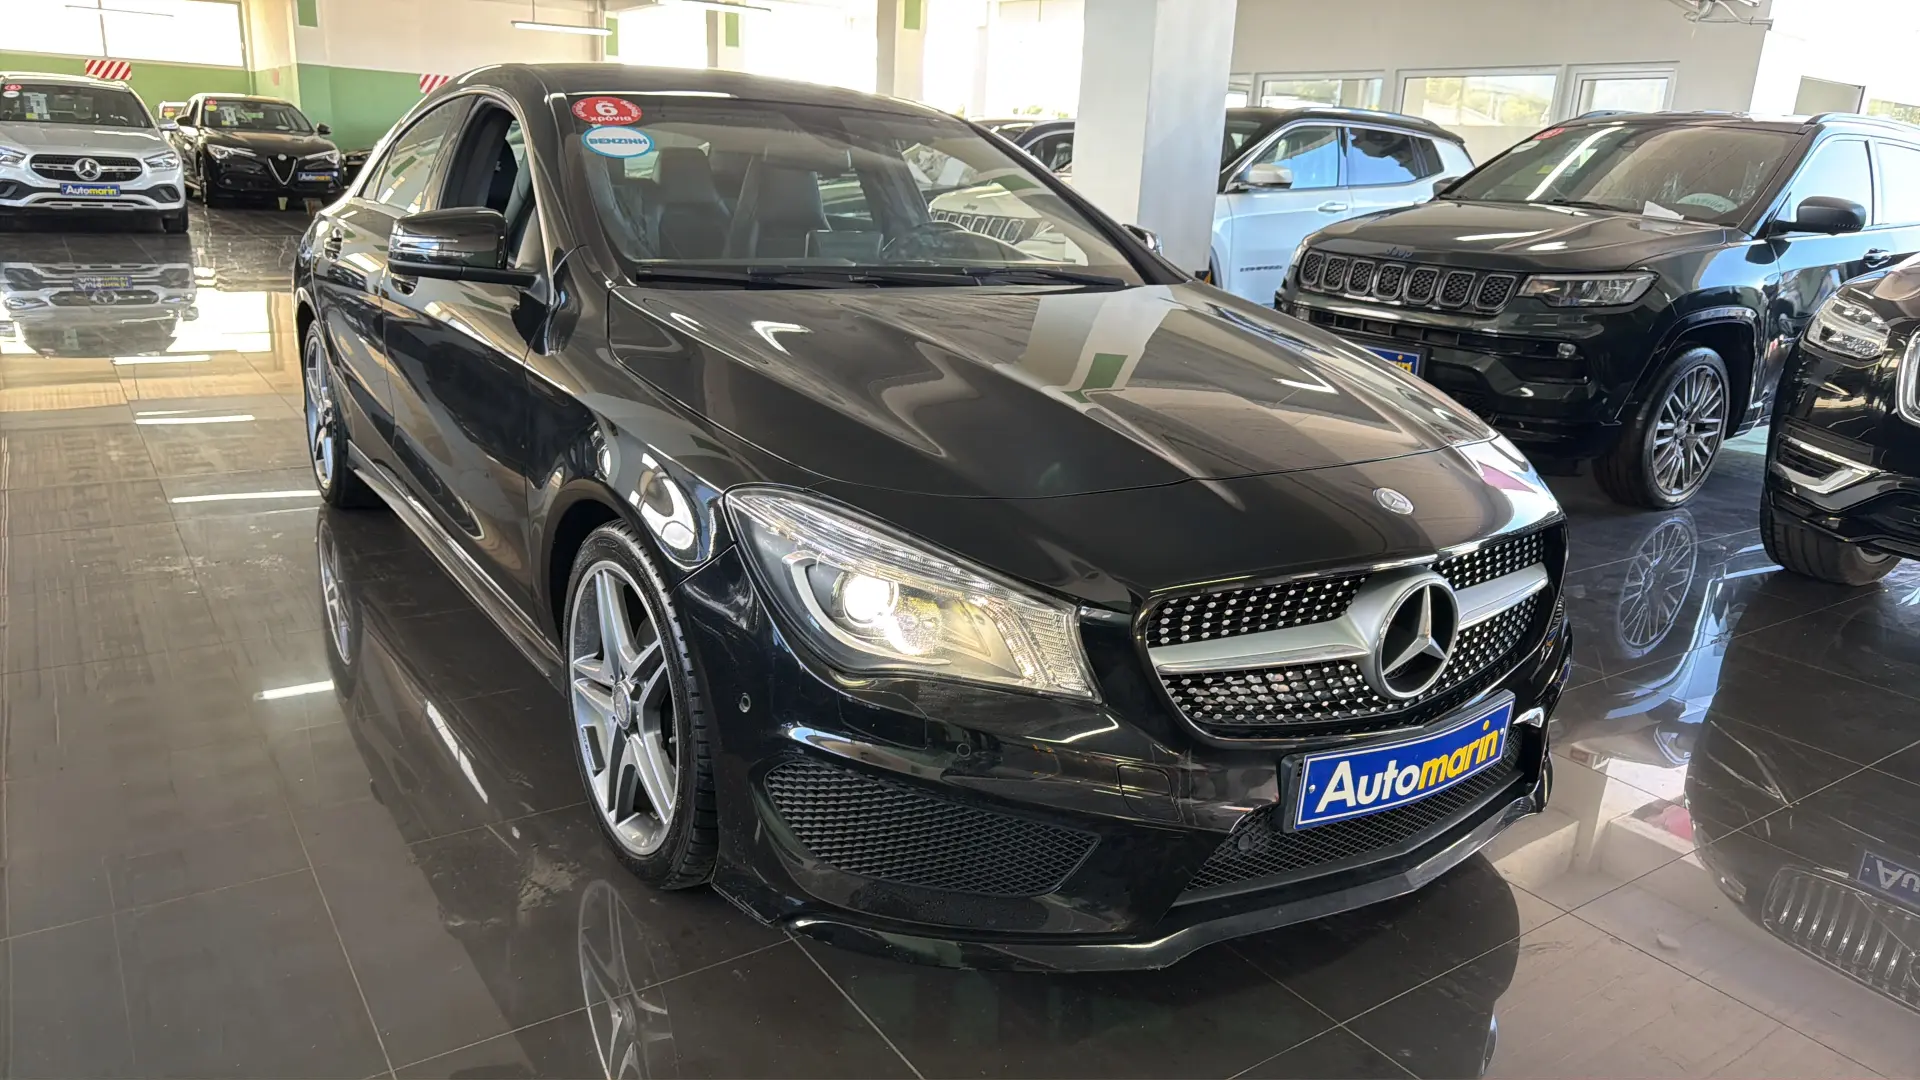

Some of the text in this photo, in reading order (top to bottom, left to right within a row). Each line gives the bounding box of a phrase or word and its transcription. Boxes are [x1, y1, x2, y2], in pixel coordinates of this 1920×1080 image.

[595, 102, 618, 116] 6
[66, 185, 117, 195] Automarin
[1315, 719, 1499, 813] Automarin
